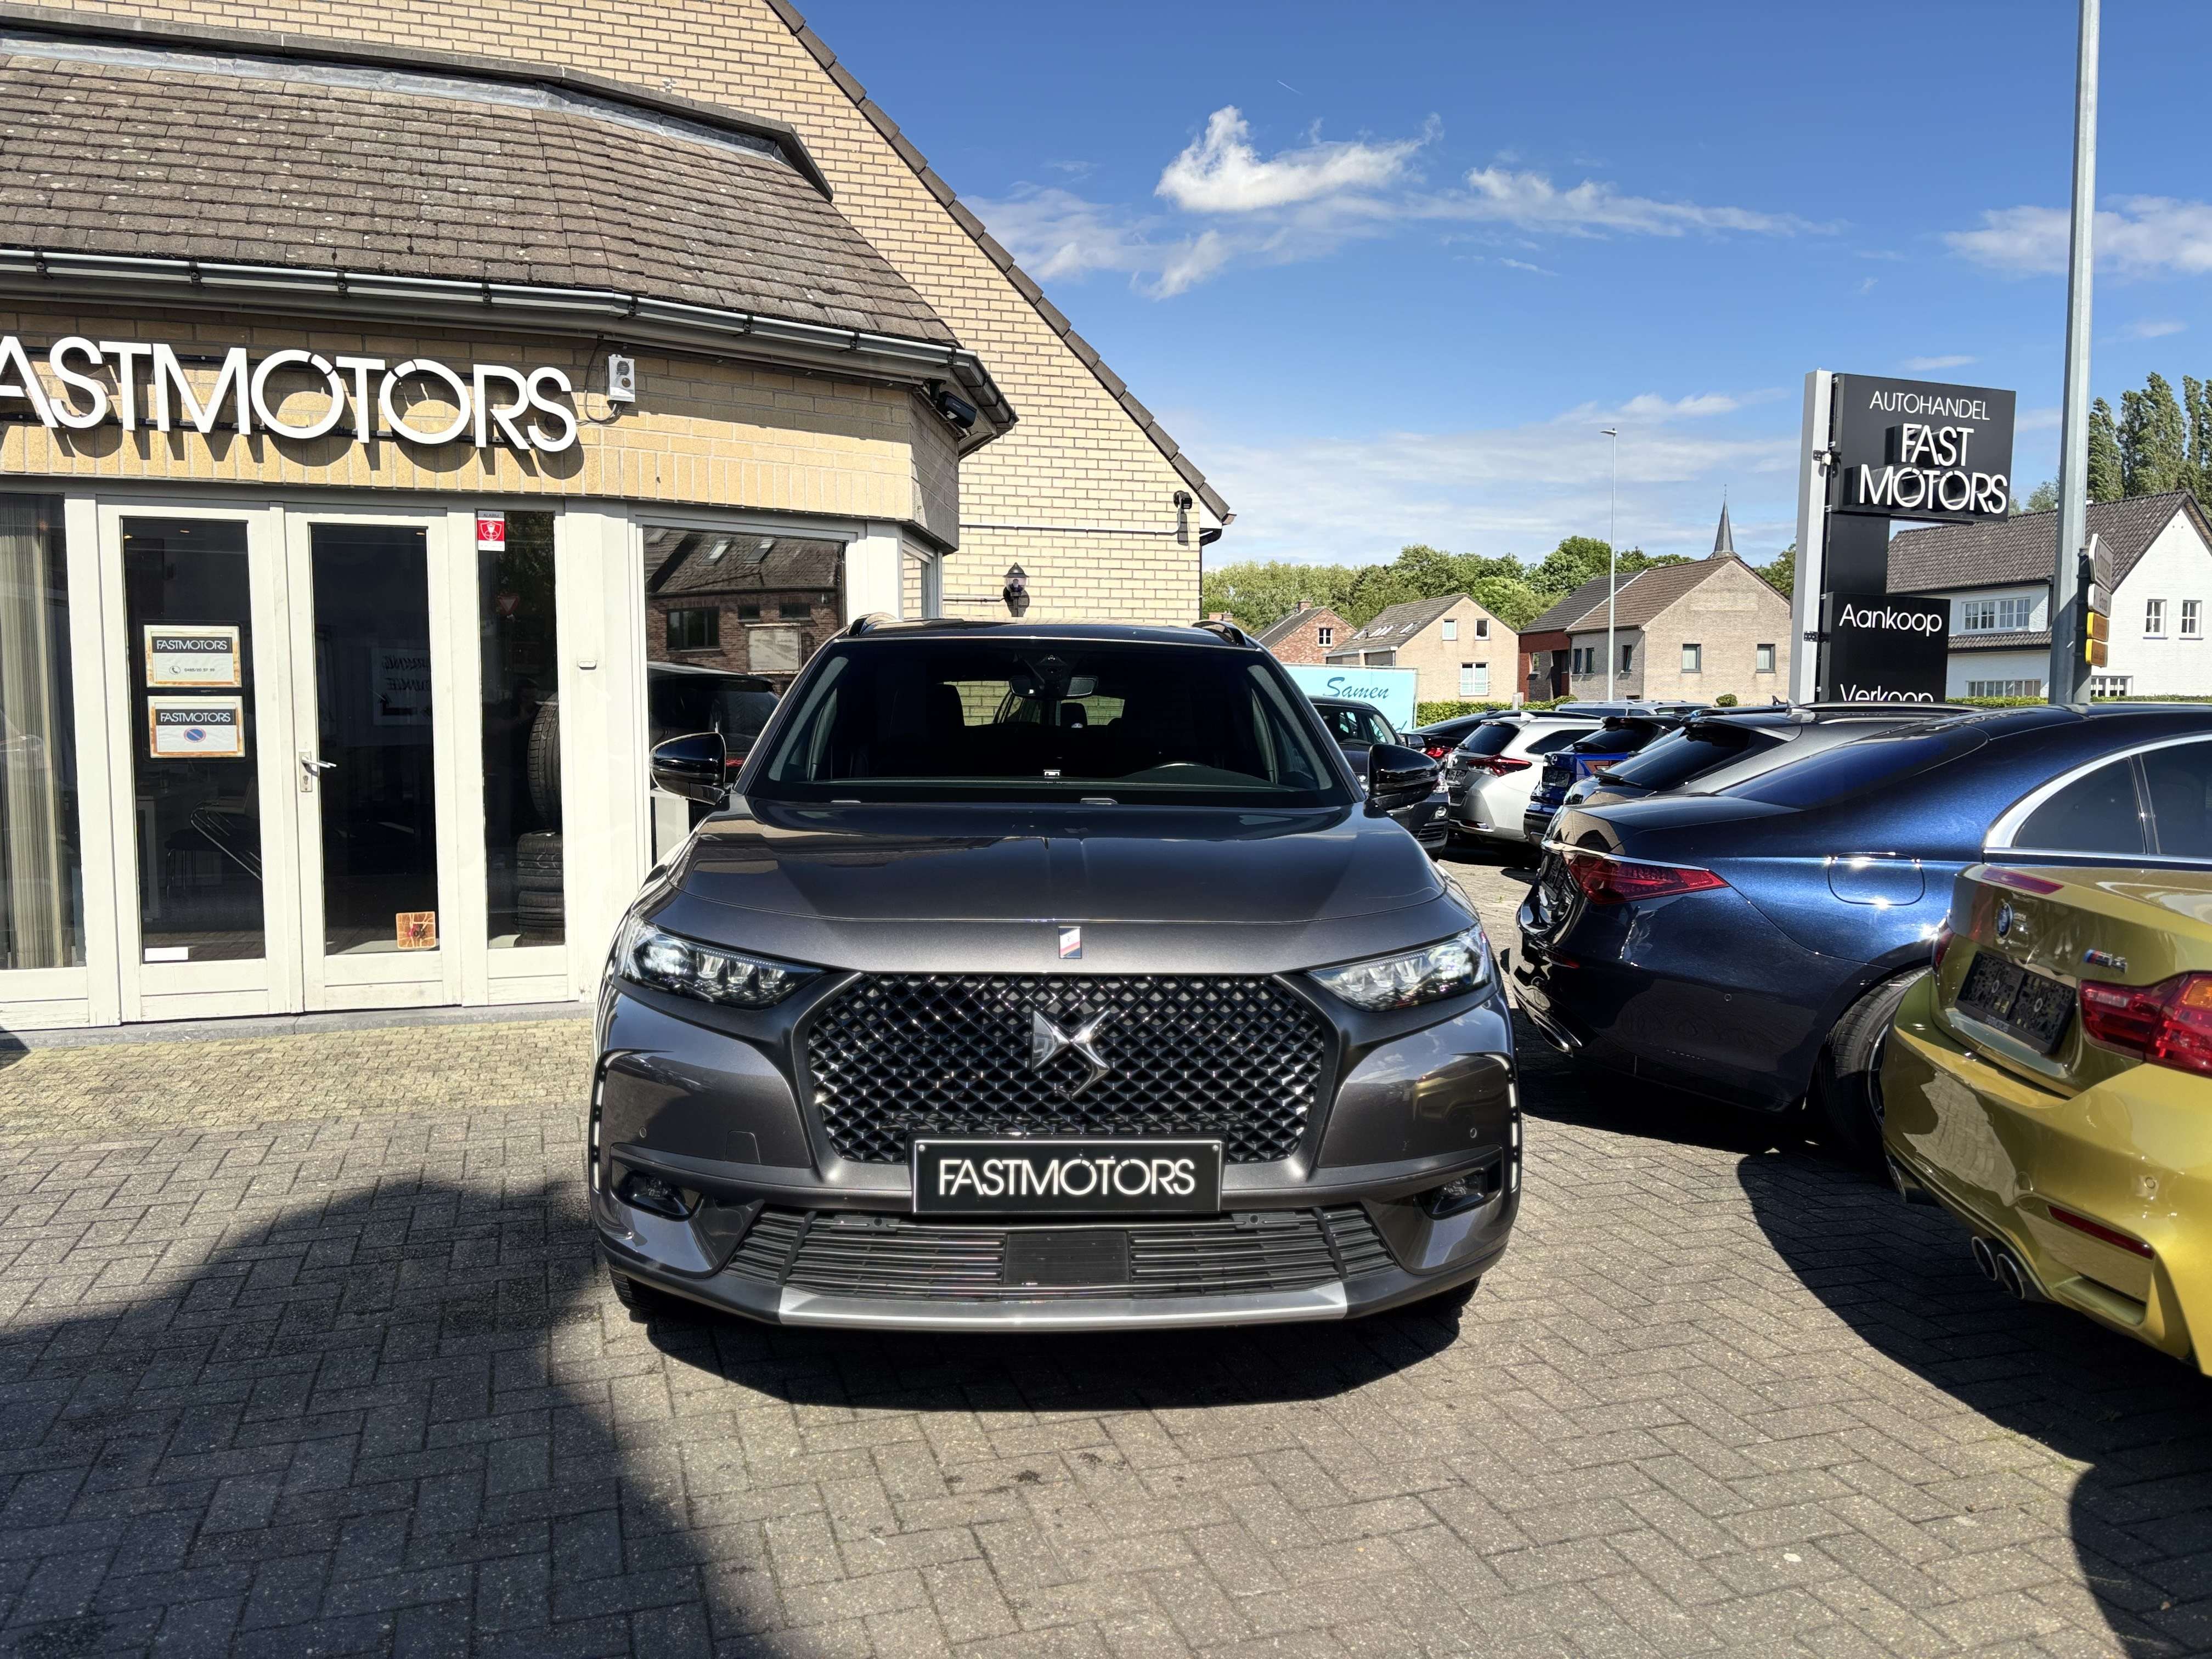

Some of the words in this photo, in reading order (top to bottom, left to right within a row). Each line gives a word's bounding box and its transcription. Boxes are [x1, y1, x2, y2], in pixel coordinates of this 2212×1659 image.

[1869, 391, 1990, 420] AUTOHANDEL
[1901, 423, 1974, 466] FAST
[1859, 464, 2007, 514] MOTORS
[1839, 603, 1942, 636] Aankoop
[156, 640, 228, 650] FASTMOTORS
[1323, 677, 1389, 699] Samen
[160, 712, 231, 723] FASTMOTORS
[939, 1159, 1195, 1195] FASTMOTORS
